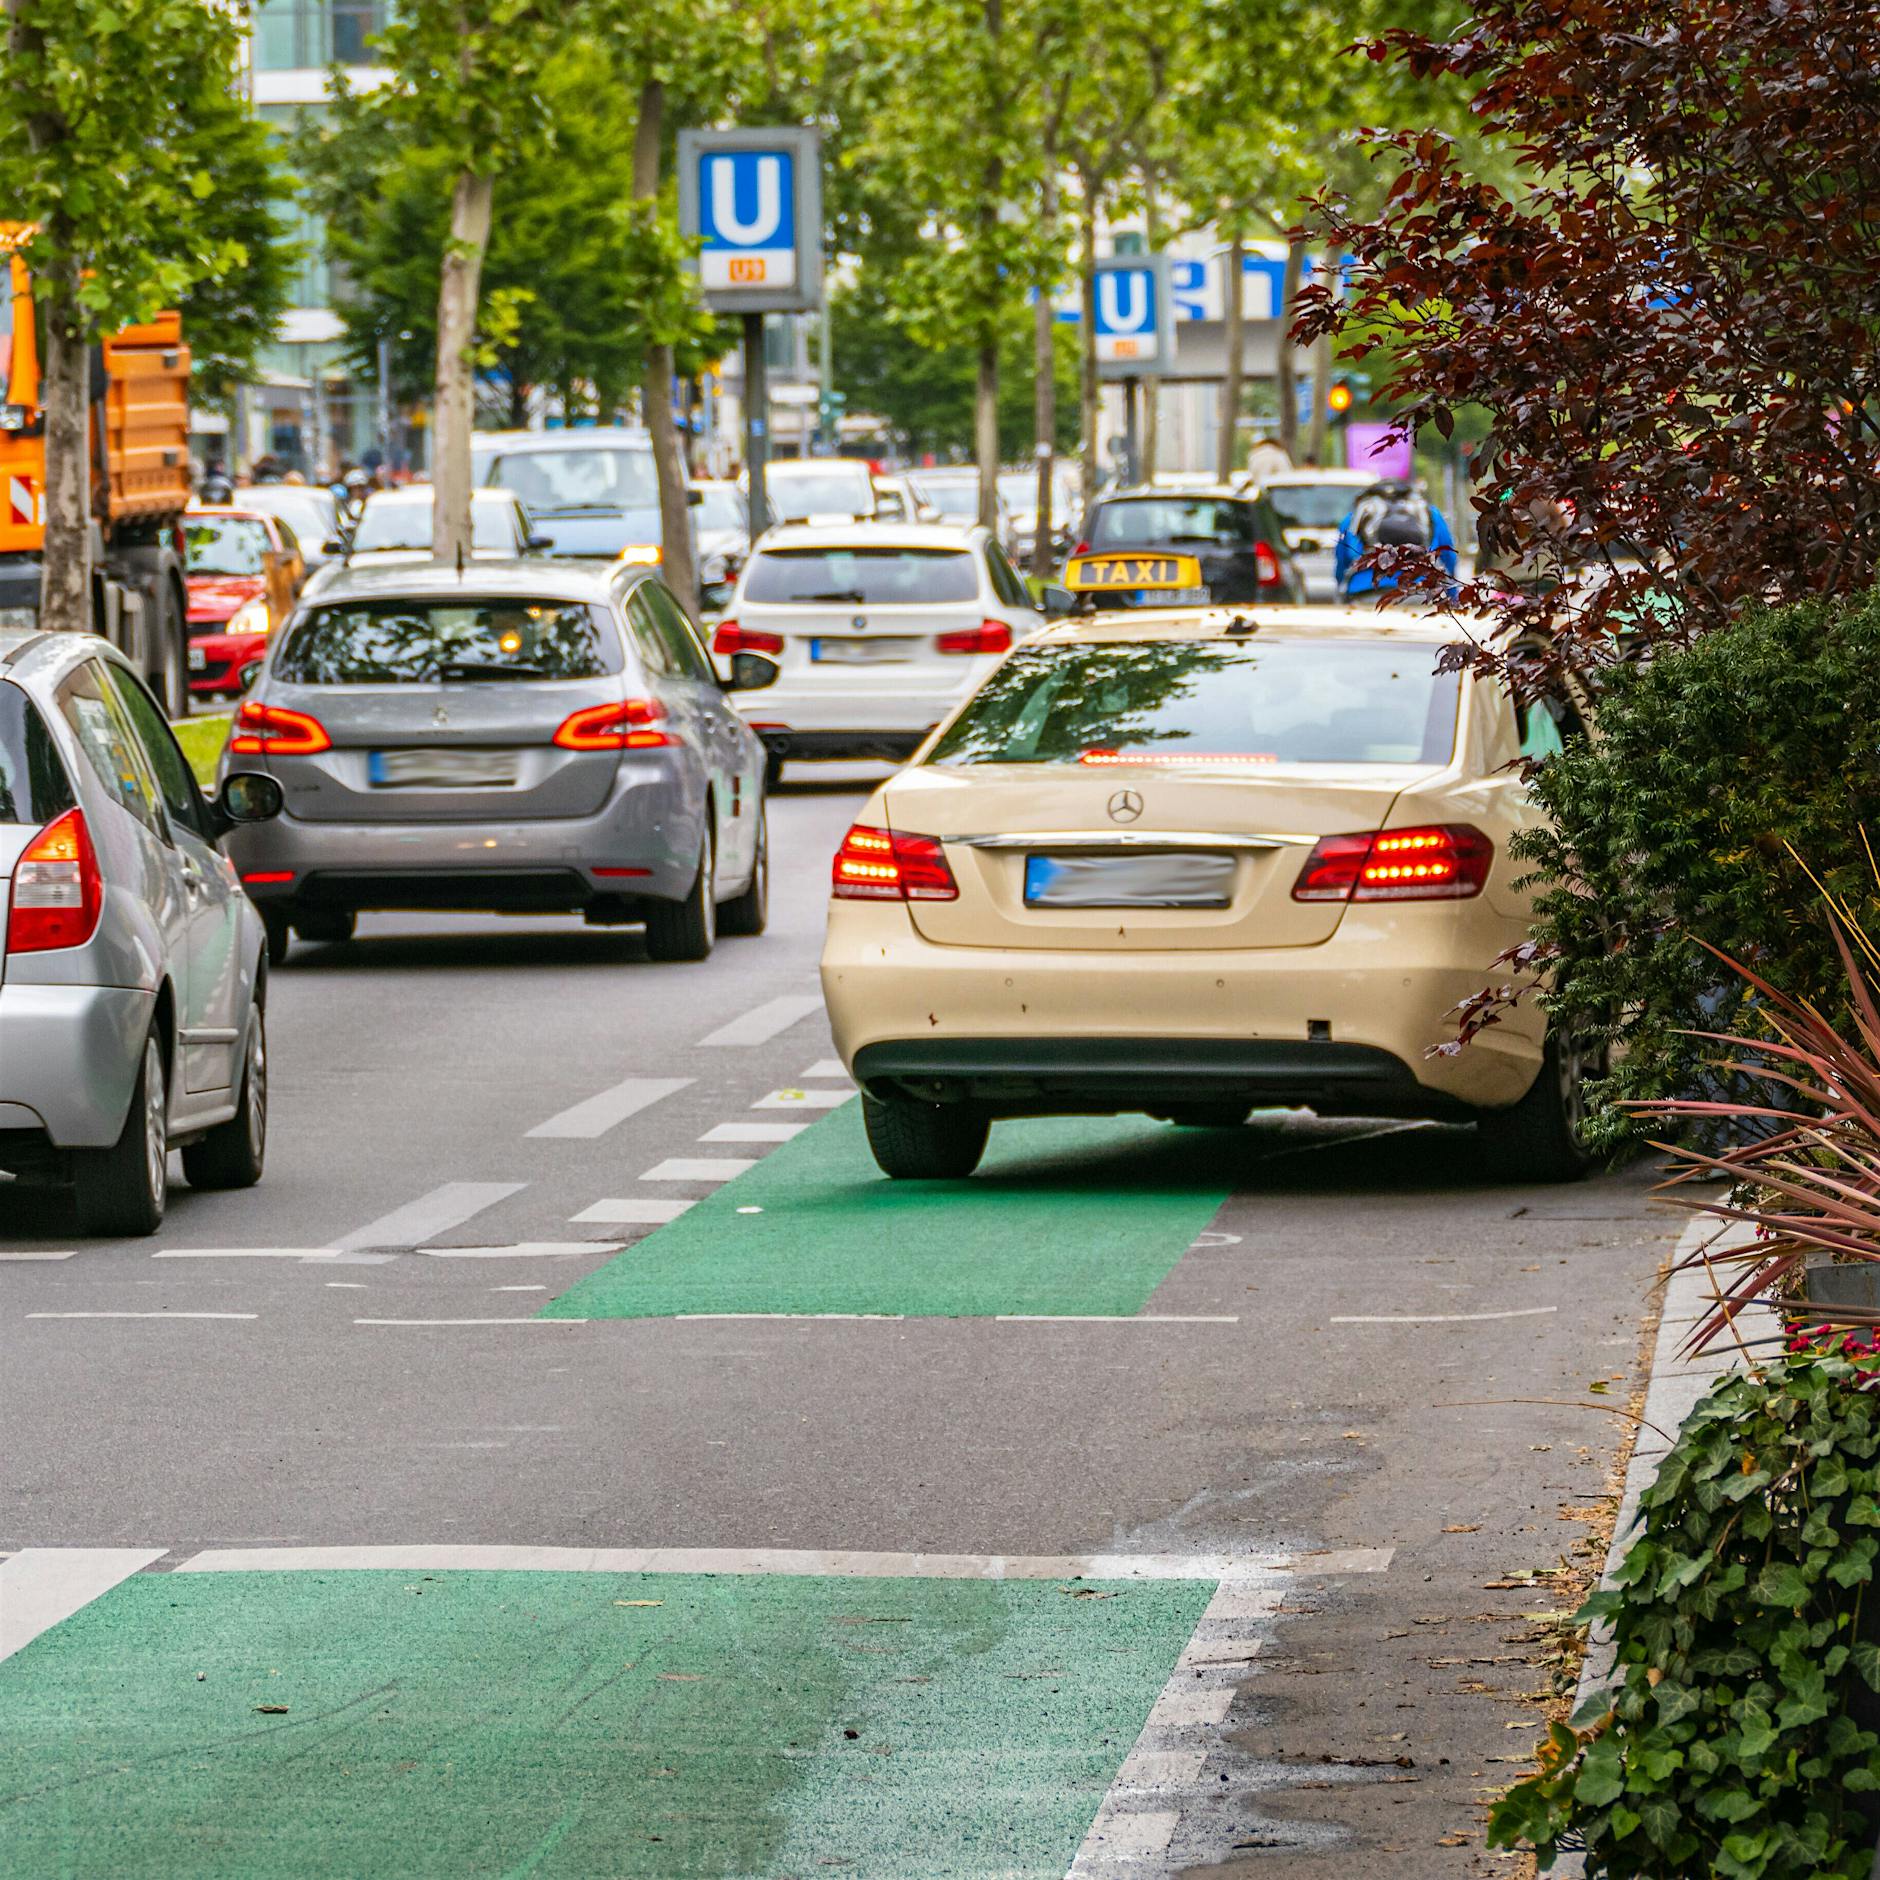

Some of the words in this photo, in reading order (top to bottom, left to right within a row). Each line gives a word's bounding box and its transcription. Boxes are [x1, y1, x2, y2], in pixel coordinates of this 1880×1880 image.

[711, 157, 780, 246] U
[1100, 272, 1149, 332] U
[1092, 560, 1168, 583] TAXI
